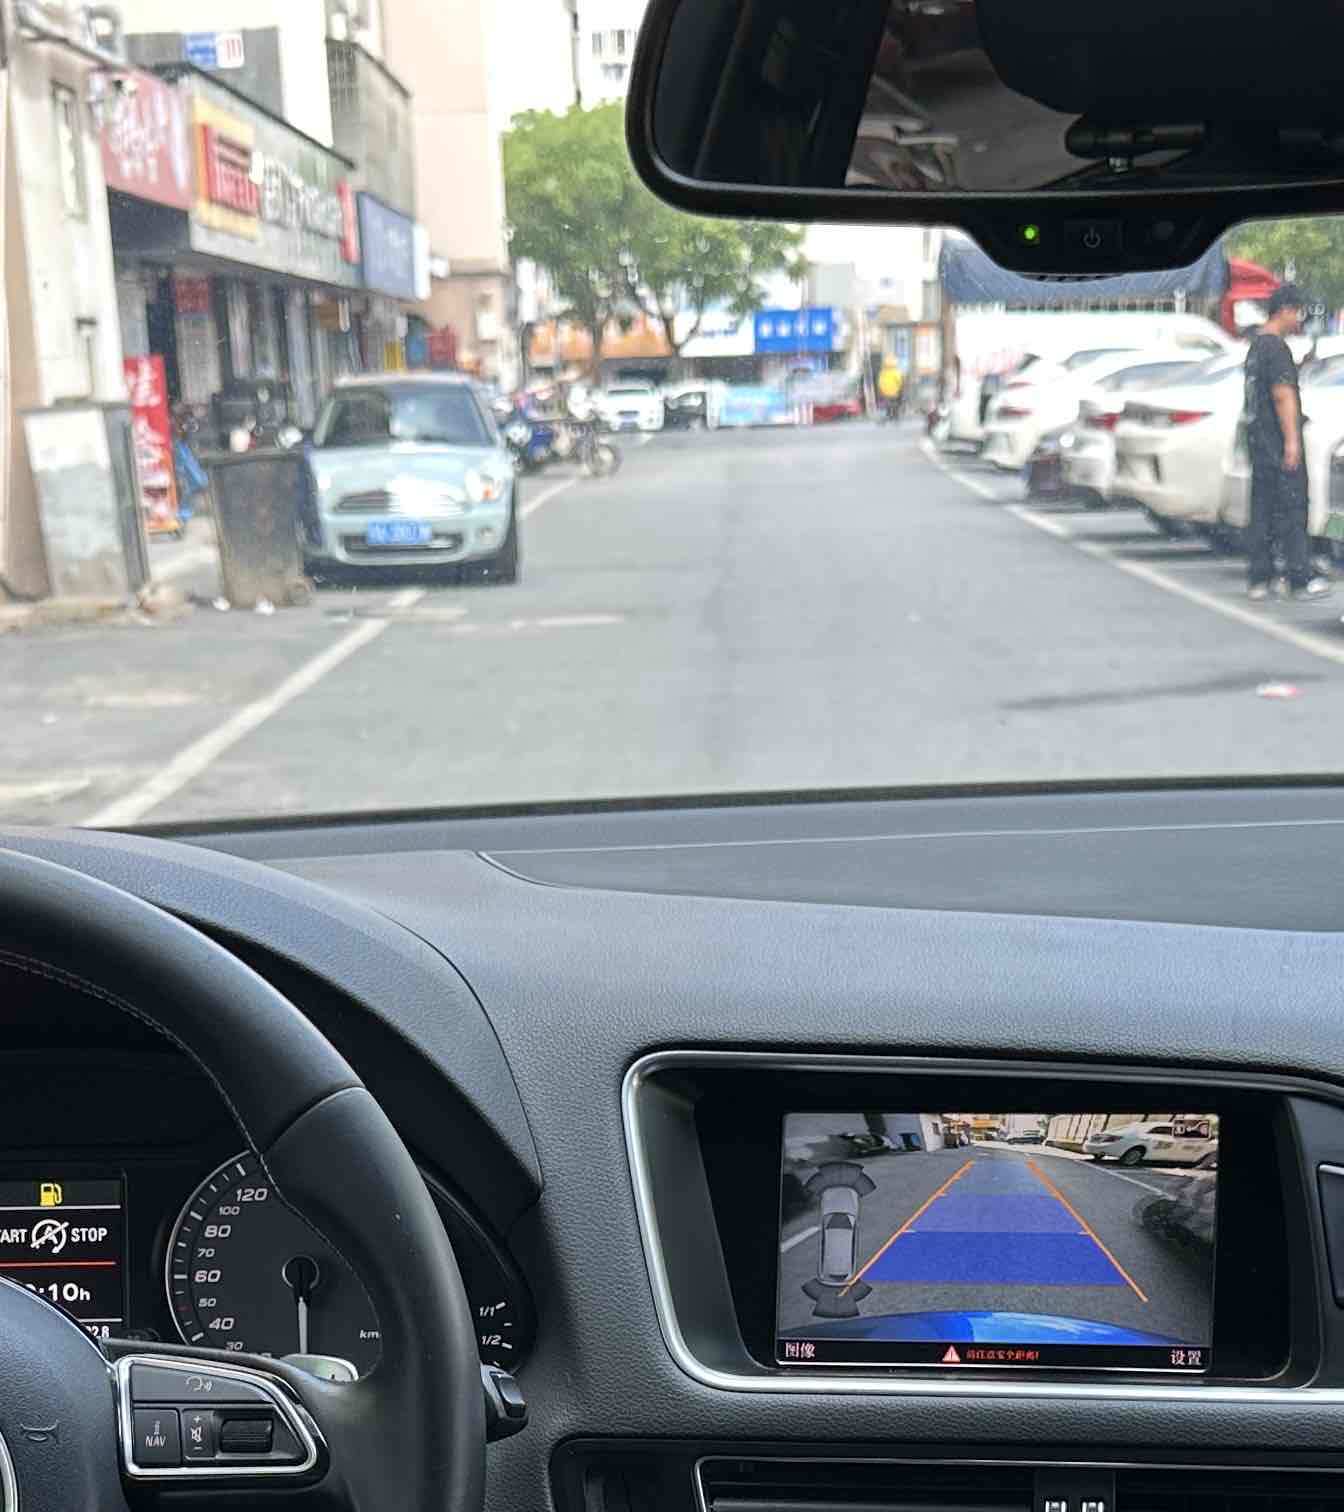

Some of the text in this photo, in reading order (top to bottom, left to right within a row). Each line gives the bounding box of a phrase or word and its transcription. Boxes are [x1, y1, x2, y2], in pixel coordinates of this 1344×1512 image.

[235, 1188, 268, 1202] 120
[218, 1206, 241, 1216] 100
[71, 1227, 108, 1242] STOP
[204, 1225, 232, 1238] 80
[197, 1248, 216, 1258] 70
[194, 1270, 221, 1282] 60
[198, 1298, 217, 1307] 50
[480, 1306, 495, 1317] 1/1
[209, 1317, 235, 1330] 40
[482, 1335, 502, 1345] 1/2
[785, 1342, 816, 1358] 图像
[1170, 1349, 1202, 1366] 设置
[145, 1435, 168, 1448] NAV
